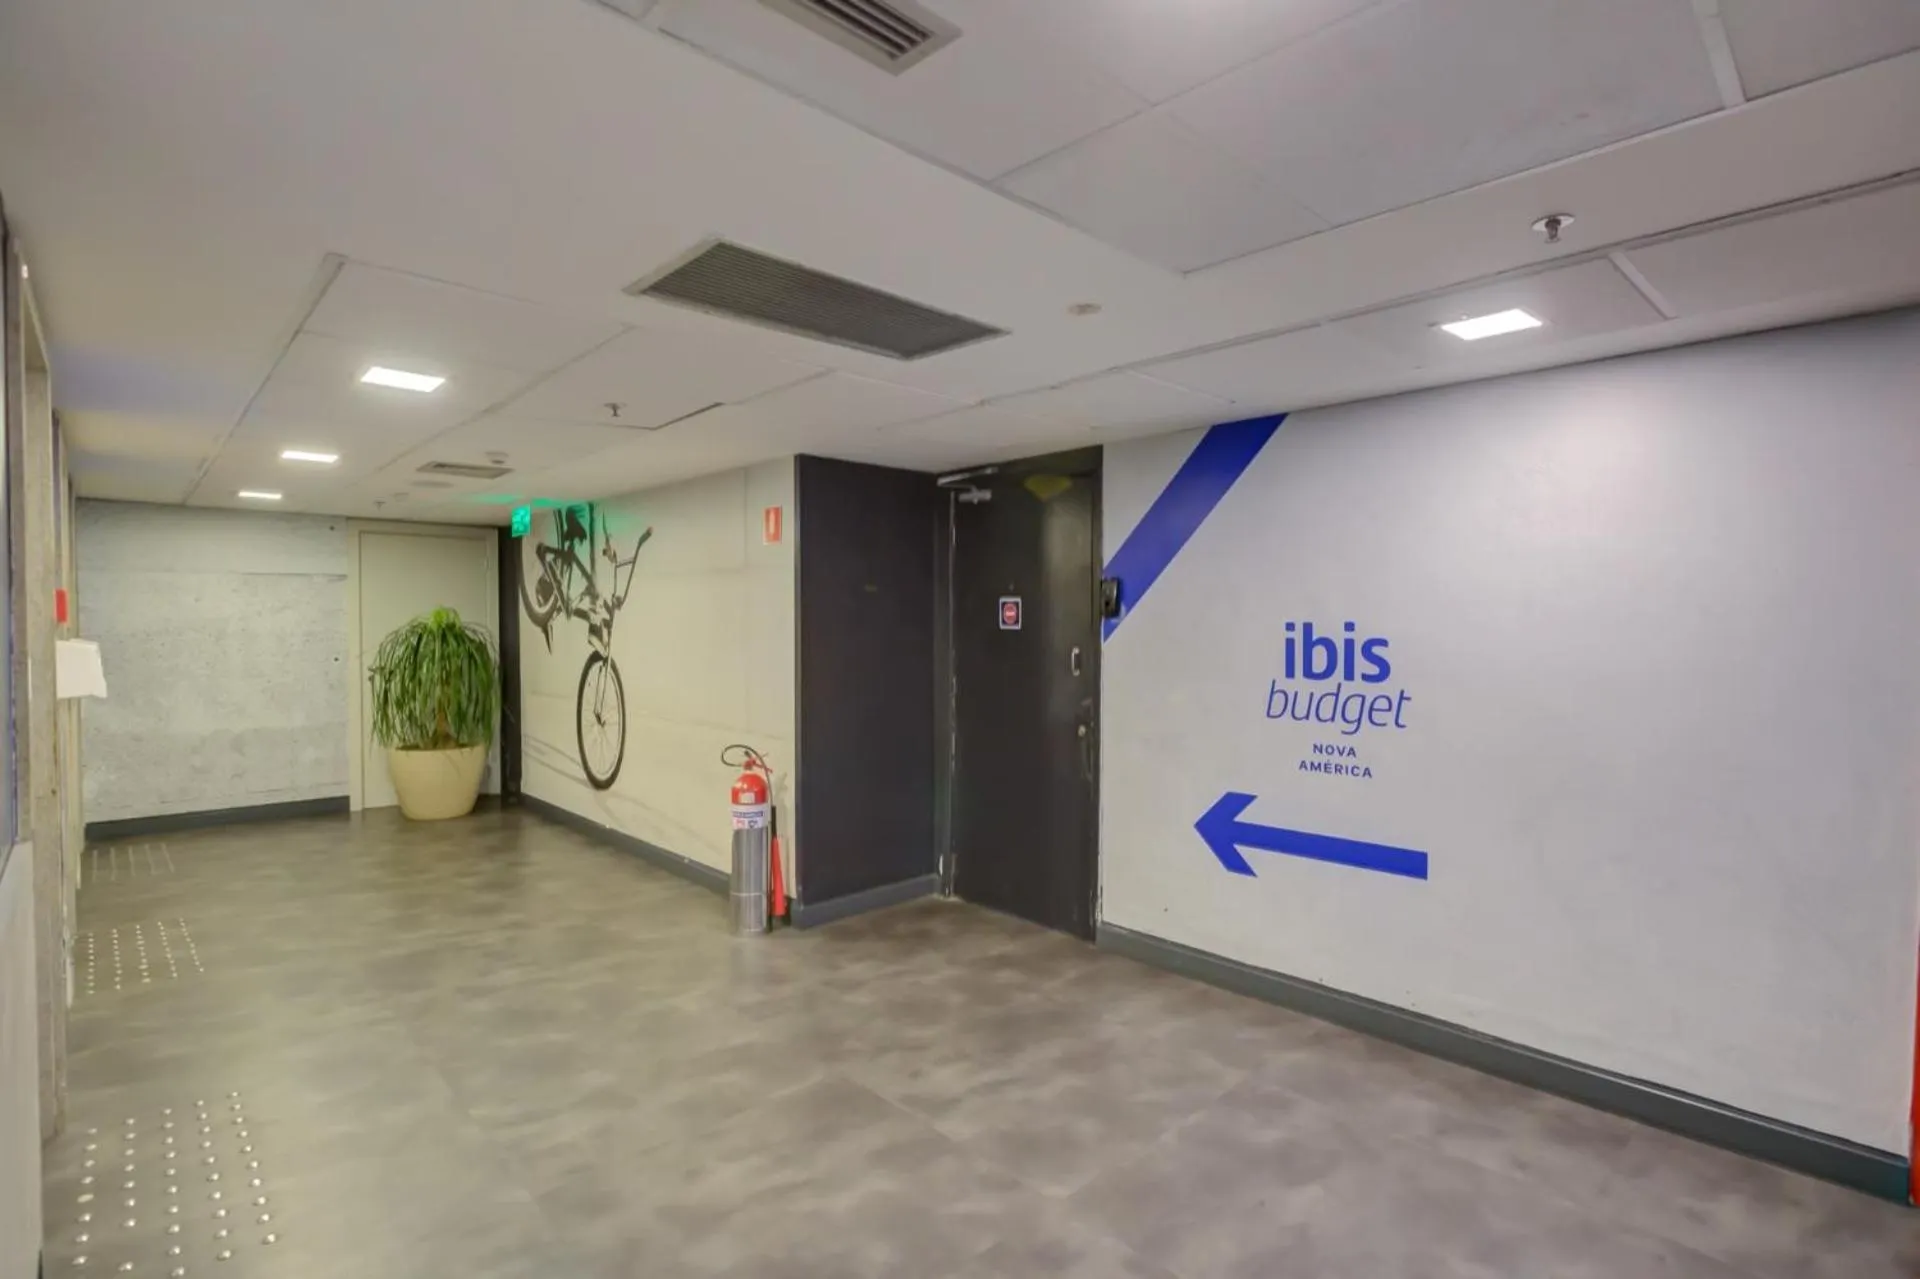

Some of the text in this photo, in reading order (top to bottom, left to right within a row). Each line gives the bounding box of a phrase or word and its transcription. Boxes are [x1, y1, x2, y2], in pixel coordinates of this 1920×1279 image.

[1285, 622, 1391, 683] ibis
[1266, 679, 1412, 735] budget
[1299, 759, 1373, 779] AMÉRICA
[1312, 743, 1357, 758] NOVA
